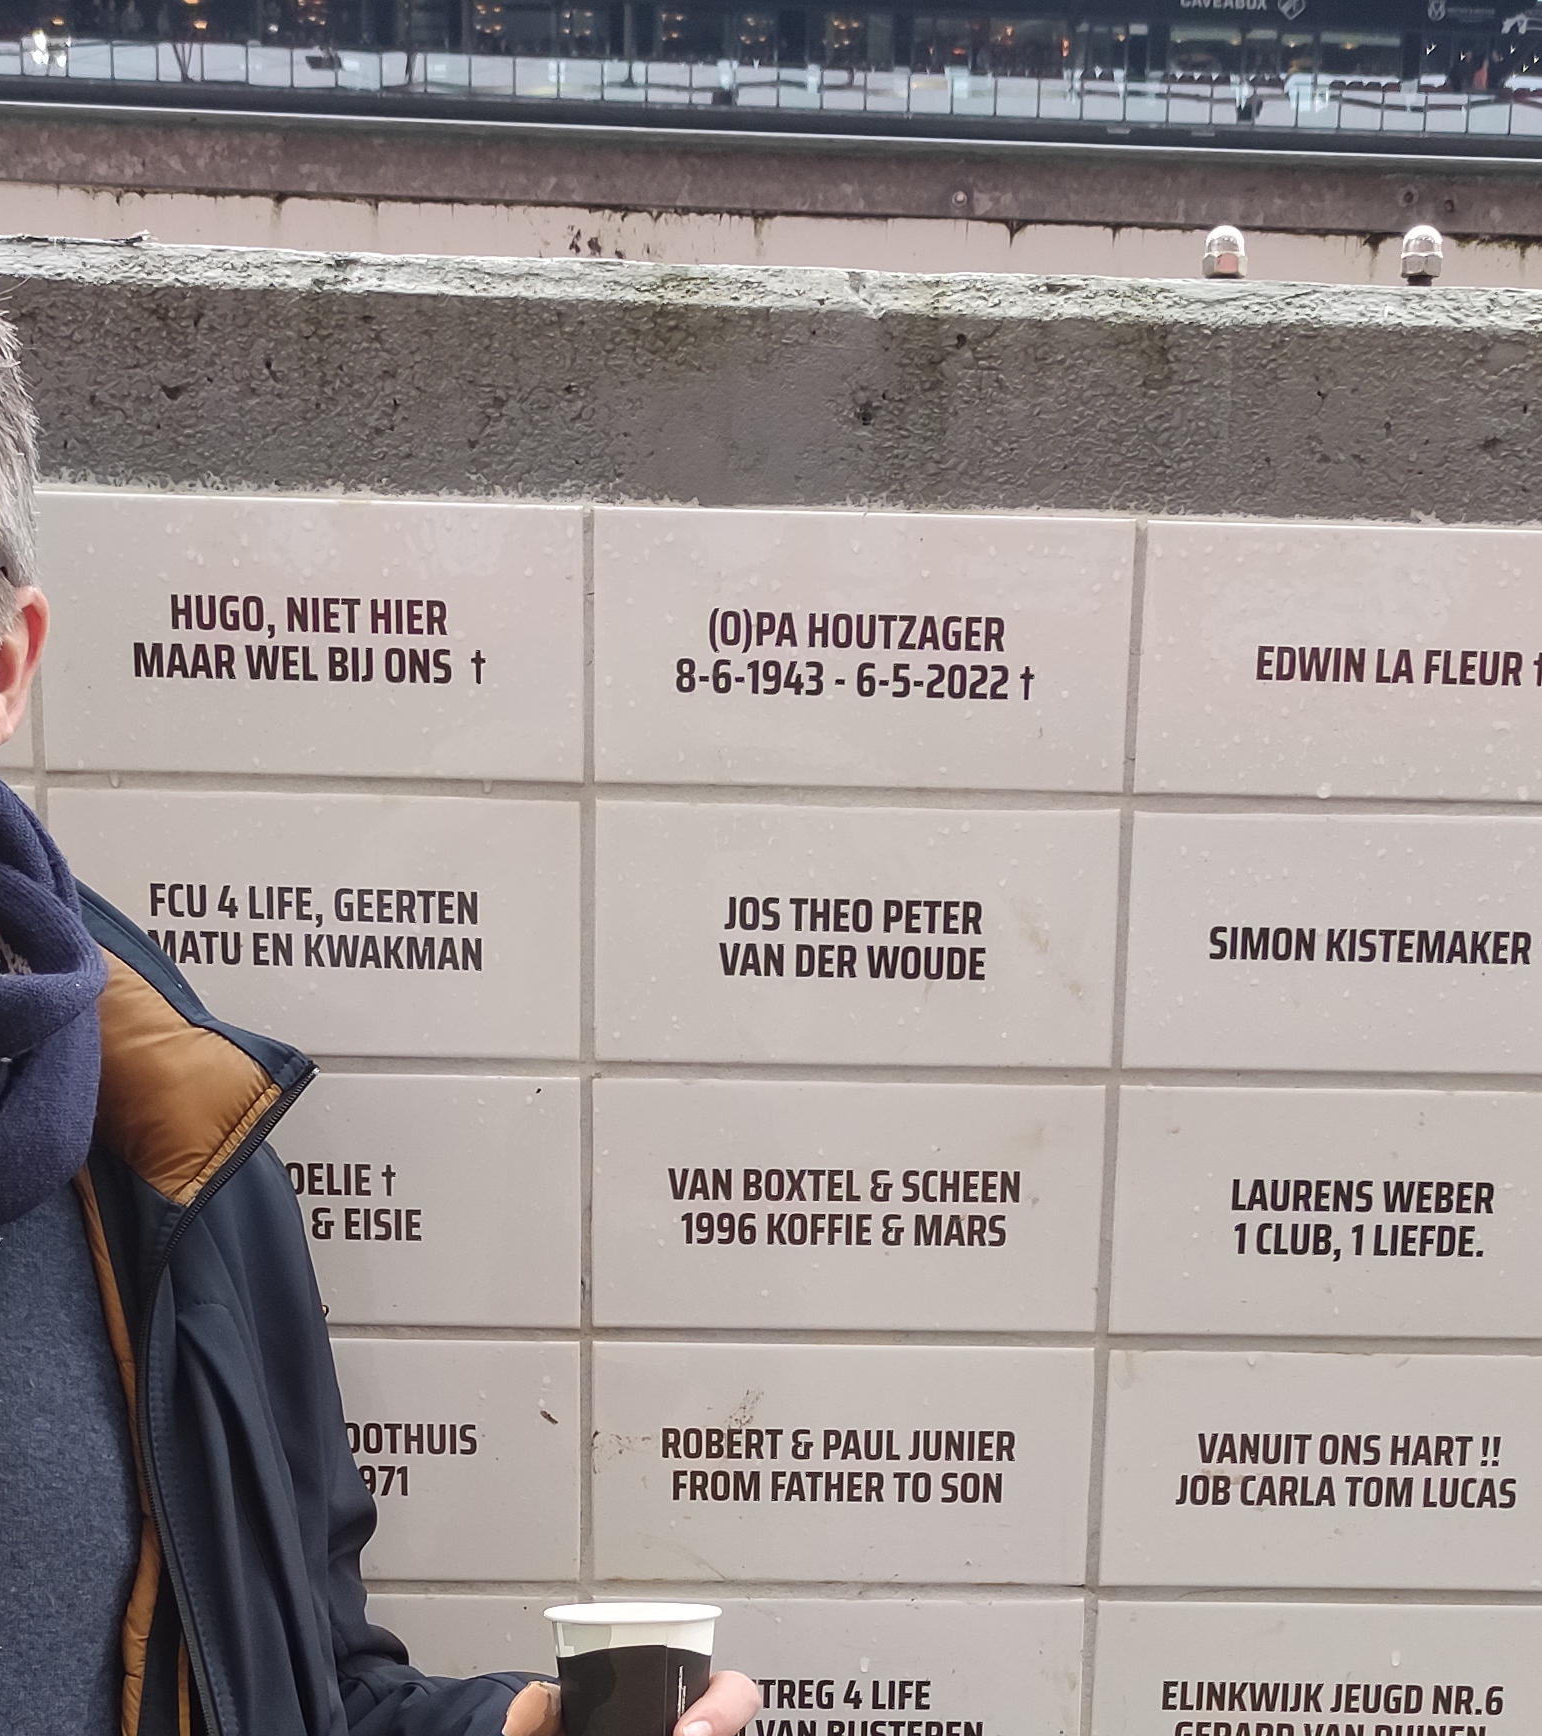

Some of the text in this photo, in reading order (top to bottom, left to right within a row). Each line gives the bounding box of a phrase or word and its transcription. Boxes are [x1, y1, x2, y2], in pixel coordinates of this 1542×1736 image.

[170, 593, 448, 640] HUGO, NIET HIER
[709, 607, 1005, 654] (O)PA HOUTZAGER
[133, 641, 452, 685] MAAR WEL BIJ ONS
[675, 657, 1009, 700] 8-6-1943 6-5-2022
[1255, 645, 1523, 687] EDWIN LA FLEUR
[150, 882, 478, 929] FCU 4 LIFE, GEERTEN
[723, 896, 983, 935] JOS THEO PETER
[147, 928, 483, 972] MATU EN KWAKMAN
[718, 942, 987, 981] VAN DER WOUDE
[1208, 925, 1532, 965] SIMON KISTEMAKER
[284, 1162, 372, 1197] OELIE
[667, 1167, 1021, 1204] VAN BOXTEL & SCHEEN
[1231, 1178, 1495, 1215] LAURENS WEBER
[311, 1207, 422, 1242] & EISIE
[680, 1212, 1007, 1247] 1996 KOFFIE & MARS
[1234, 1222, 1484, 1263] 1 CLUB, 1 LIEFDE.
[345, 1422, 478, 1456] OOTHUIS
[661, 1424, 1016, 1462] ROBERT & PAUL JUNIER
[1197, 1432, 1502, 1467] VANUIT ONS HART !!
[358, 1465, 409, 1497] 971
[672, 1469, 1003, 1504] FROM FATHER TO SON
[1175, 1474, 1517, 1509] JOB CARLA TOM LUCAS
[754, 1679, 932, 1710] TREG 4 LIFE
[1161, 1680, 1504, 1716] ELINKWIJK JEUGD NR.6
